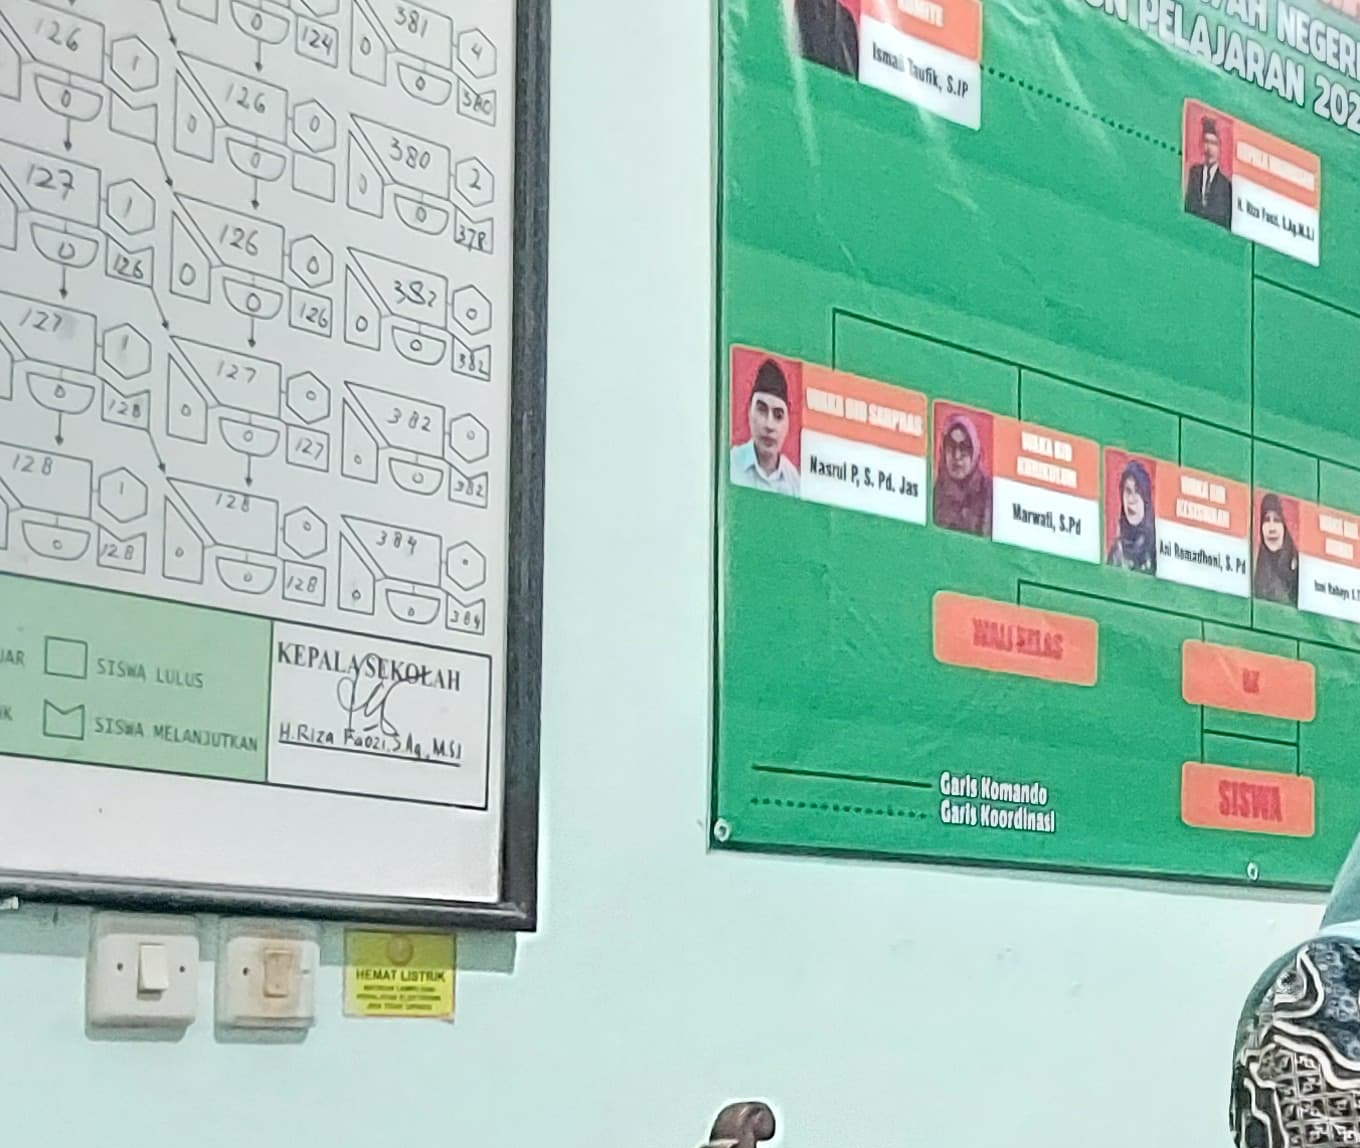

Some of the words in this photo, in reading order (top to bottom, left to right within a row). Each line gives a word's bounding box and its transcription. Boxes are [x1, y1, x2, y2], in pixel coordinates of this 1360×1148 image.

[36, 19, 81, 51] 126
[395, 6, 428, 38] 381
[302, 26, 334, 55] 124
[472, 44, 482, 60] 4
[1138, 0, 1305, 107] PELAJARAN
[225, 83, 266, 113] 126
[390, 137, 430, 169] 380
[27, 164, 74, 200] 127
[471, 168, 481, 190] 2
[220, 225, 258, 256] 126
[114, 254, 143, 279] 126
[20, 309, 62, 331] 127
[300, 303, 328, 328] 126
[217, 361, 256, 384] 127
[109, 400, 140, 418] 128
[296, 438, 324, 460] 127
[13, 454, 53, 475] 128
[810, 455, 846, 482] Nasrul
[900, 476, 918, 497] Jas
[216, 493, 249, 512] 128
[1013, 503, 1055, 532] Marwati,
[1060, 514, 1081, 535] S.Pd
[101, 544, 134, 560] 128
[287, 576, 318, 592] 128
[97, 658, 146, 680] SISWA
[157, 668, 204, 688] LULUS
[278, 641, 358, 674] KEPALA
[365, 654, 460, 691] SEKOLAH
[95, 717, 144, 738] SISWA
[154, 725, 257, 752] MELANJUTKAN
[941, 771, 978, 798] Garis
[981, 776, 1048, 805] Komando
[1219, 779, 1283, 823] SISWA
[941, 799, 977, 826] Garis
[981, 804, 1055, 832] Koordinasi
[356, 969, 397, 980] HEMAT
[400, 970, 446, 983] LISTRIK
